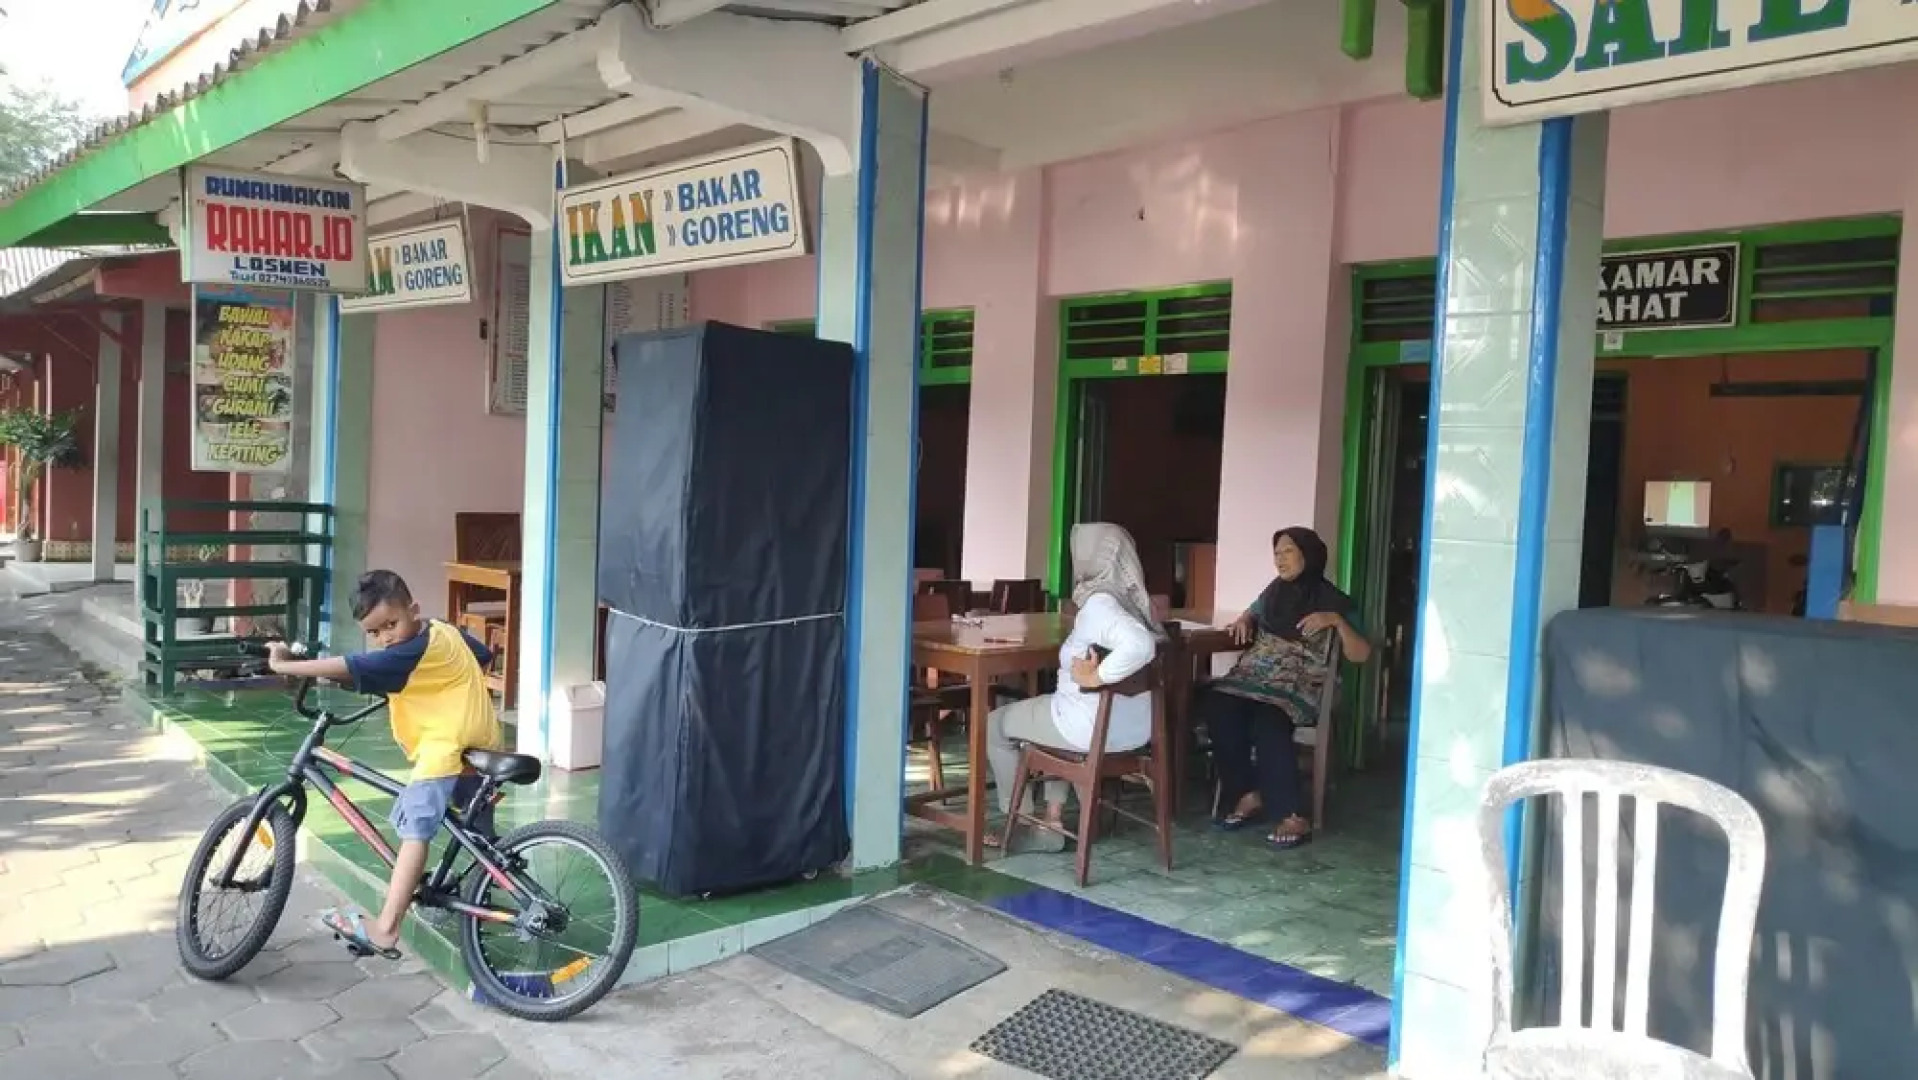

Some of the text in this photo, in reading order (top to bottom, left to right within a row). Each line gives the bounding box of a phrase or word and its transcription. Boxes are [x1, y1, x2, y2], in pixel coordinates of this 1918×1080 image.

[677, 168, 763, 211] BAKAR
[565, 190, 657, 267] IKAN
[681, 204, 789, 247] GORENG
[402, 238, 448, 265] BAKAR
[405, 263, 463, 290] GORENG
